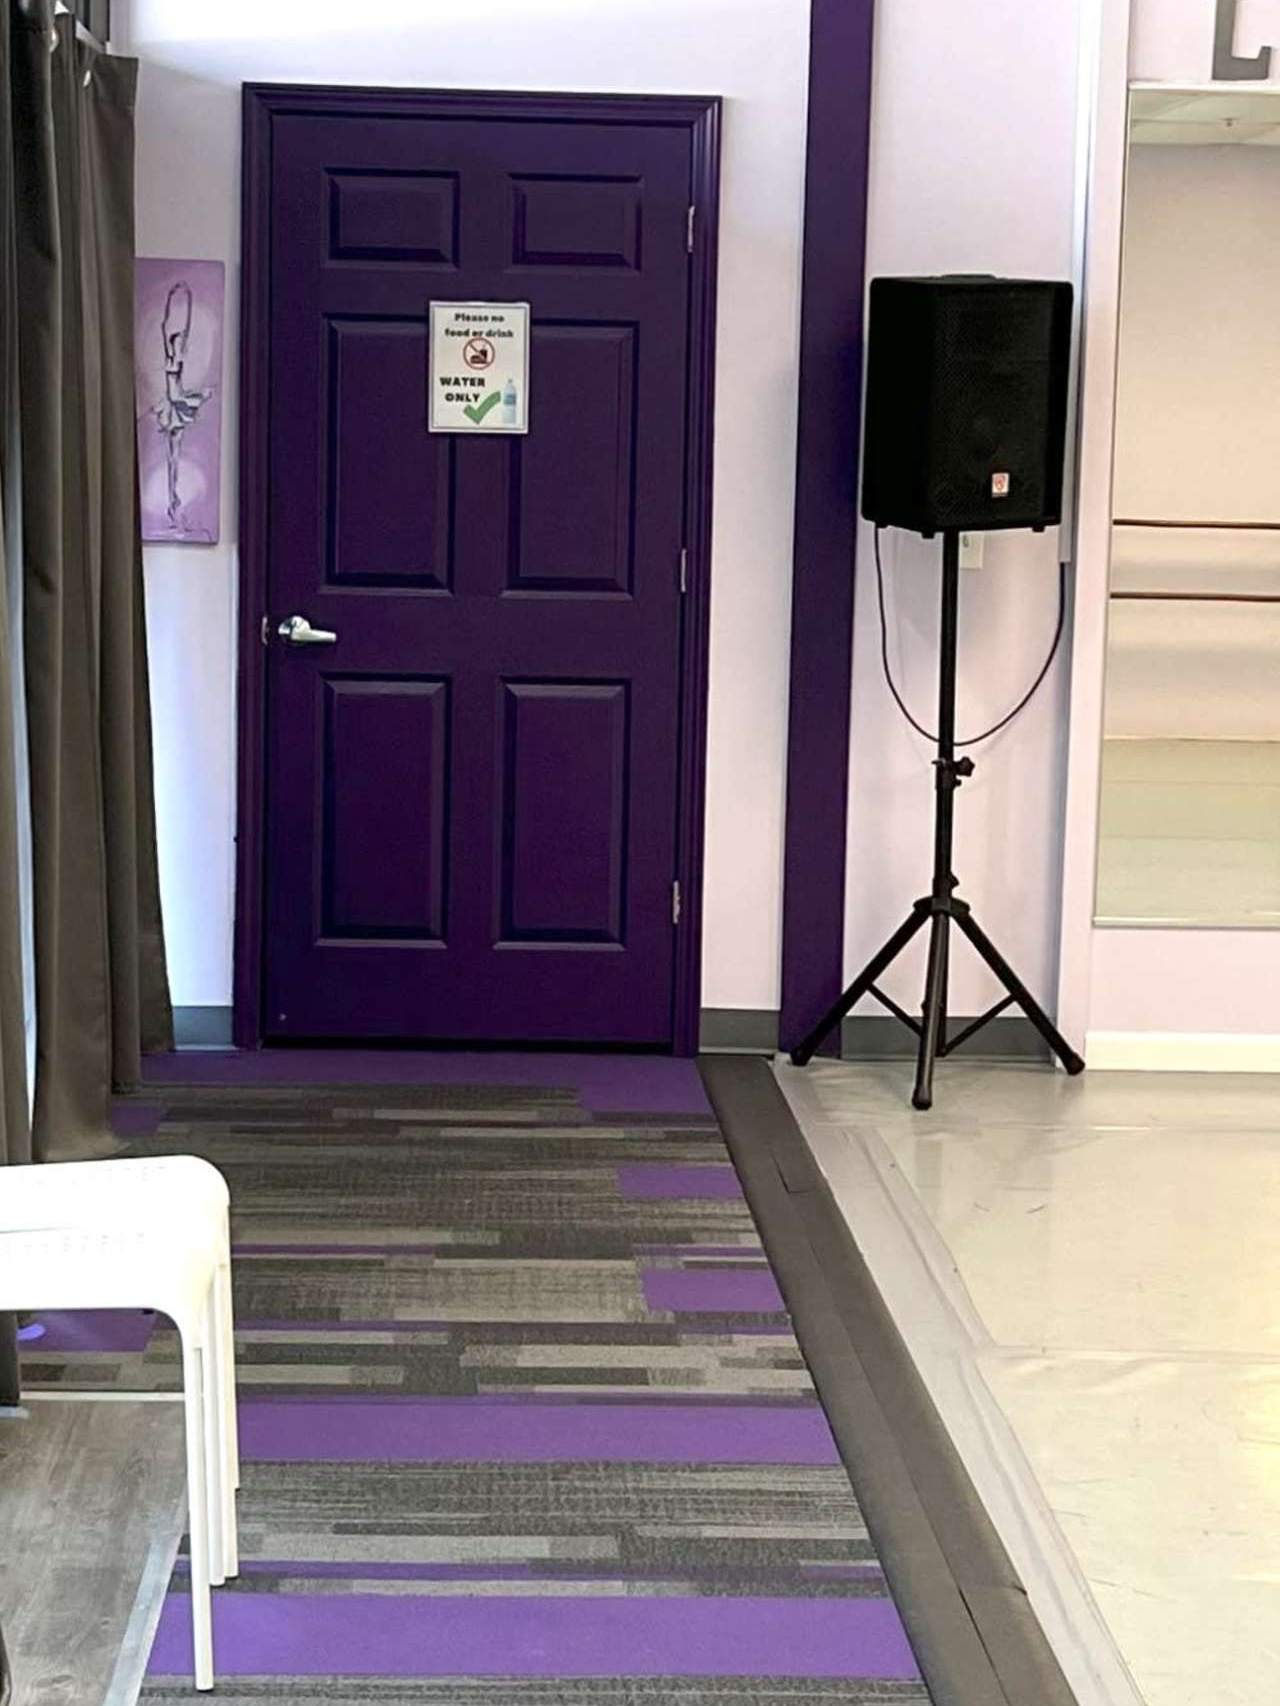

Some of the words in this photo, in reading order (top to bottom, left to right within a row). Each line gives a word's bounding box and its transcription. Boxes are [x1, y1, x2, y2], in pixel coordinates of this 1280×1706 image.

[455, 313, 489, 322] Please
[491, 314, 505, 323] no
[444, 328, 470, 337] food
[485, 329, 514, 338] drink
[440, 377, 486, 387] WATER
[445, 393, 480, 402] ONLY
